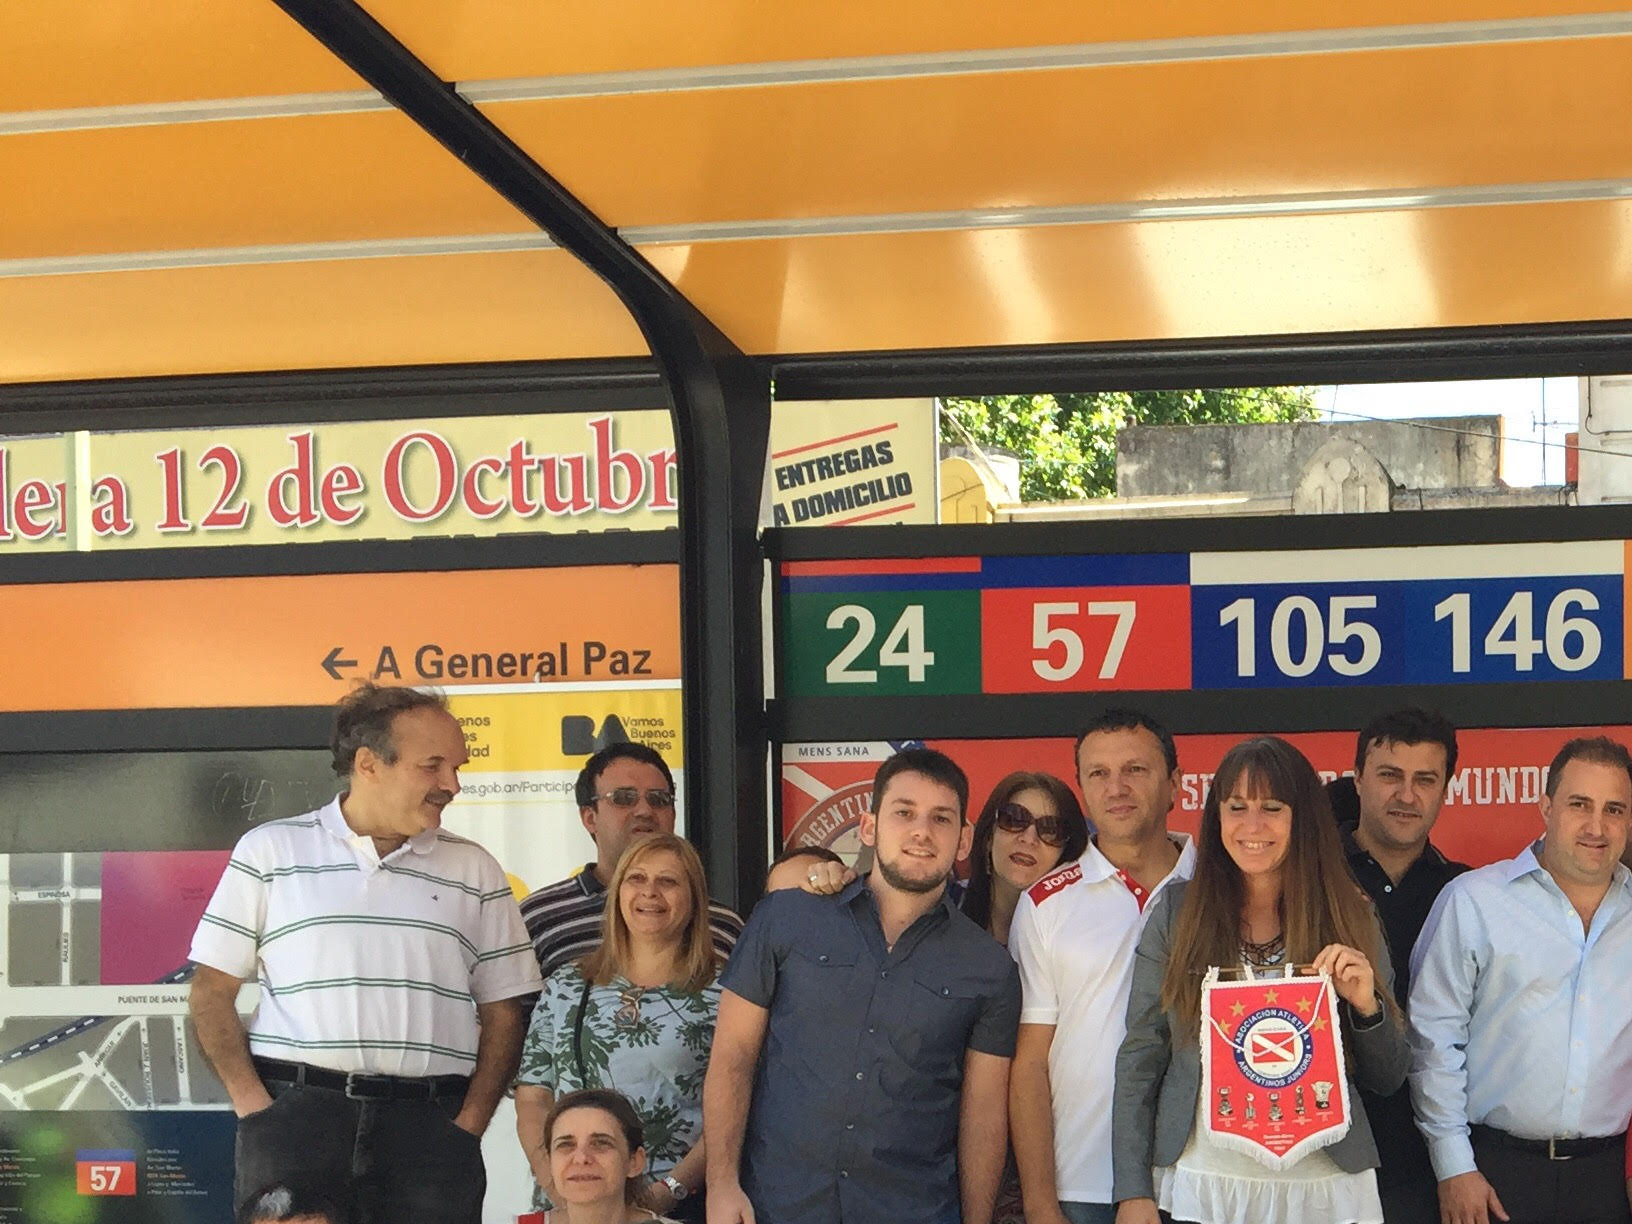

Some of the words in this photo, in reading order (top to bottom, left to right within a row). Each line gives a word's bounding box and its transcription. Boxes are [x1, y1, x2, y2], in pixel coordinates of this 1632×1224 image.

[155, 446, 248, 529] 12
[267, 431, 363, 526] de
[383, 416, 678, 520] Octubr
[774, 440, 894, 491] ENTREGAS
[773, 502, 790, 528] A
[791, 471, 913, 523] DOMICILIO
[825, 604, 935, 683] 24
[1031, 600, 1137, 682] 57
[1218, 595, 1382, 678] 105
[1434, 588, 1602, 673] 146
[375, 646, 401, 679] A
[415, 641, 568, 680] General
[583, 641, 652, 676] Paz
[458, 715, 491, 727] enos
[622, 716, 664, 727] Vamos
[631, 728, 675, 739] Buenos
[798, 747, 832, 758] MENS
[837, 746, 870, 757] SANA
[1445, 766, 1550, 806] MUND
[117, 995, 147, 1004] PUENTE
[149, 995, 159, 1003] DE
[161, 995, 178, 1003] SAN
[1235, 1009, 1277, 1044] ASOCIACION
[1278, 1010, 1310, 1041] ATLETIA
[1238, 1061, 1287, 1087] ARGENTINOS
[1287, 1053, 1313, 1087] JUNIORS
[90, 1165, 122, 1192] 57
